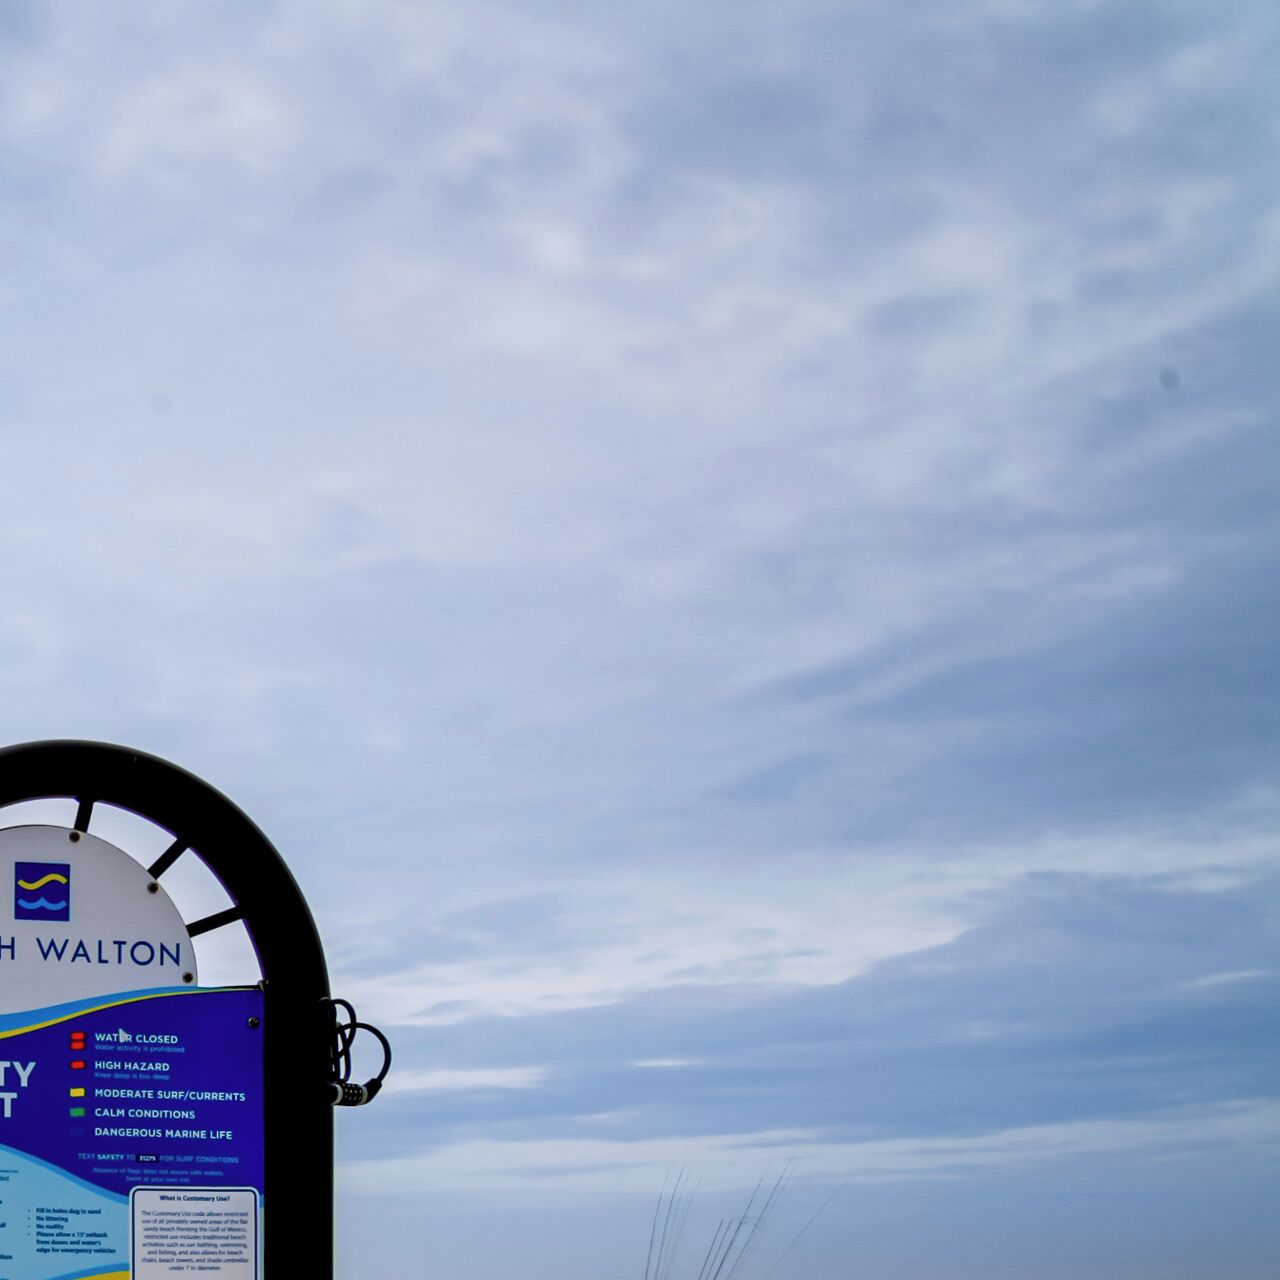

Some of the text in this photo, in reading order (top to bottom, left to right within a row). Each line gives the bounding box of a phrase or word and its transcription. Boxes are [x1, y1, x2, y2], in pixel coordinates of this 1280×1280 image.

[36, 937, 181, 966] WALTON
[136, 1034, 178, 1044] CLOSED
[94, 1061, 170, 1071] HIGH HAZARD
[94, 1088, 246, 1102] MODERATE SURF/CURRENTS
[94, 1108, 196, 1120] CALM CONDITIONS
[94, 1128, 232, 1140] DANGEROUS MARINE LIFE
